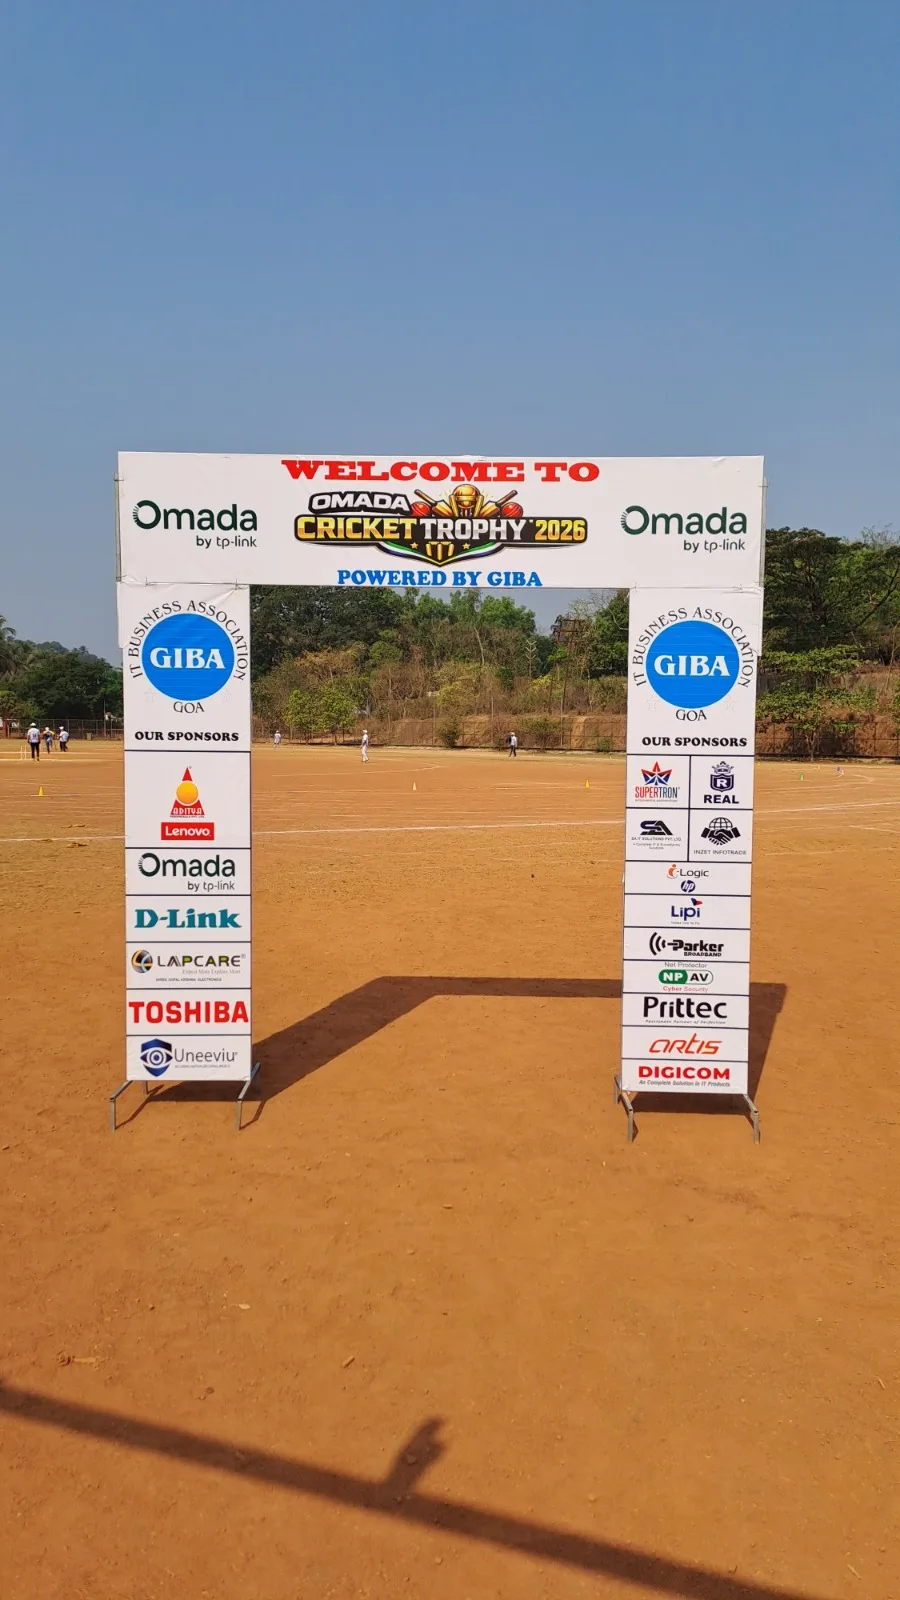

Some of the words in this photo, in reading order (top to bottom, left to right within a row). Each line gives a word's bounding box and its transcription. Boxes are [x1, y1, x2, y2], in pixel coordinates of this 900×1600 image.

[281, 460, 524, 482] WELCOME
[534, 462, 599, 482] TO
[311, 493, 411, 512] OMADA
[133, 500, 257, 531] Omada
[621, 506, 747, 535] Omada
[297, 516, 417, 539] CRICKET
[420, 519, 526, 540] TROPHY
[534, 519, 586, 541] 2026
[196, 536, 211, 549] by
[217, 535, 256, 549] tp-link
[684, 540, 699, 553] by
[704, 539, 745, 553] tp-link
[337, 570, 446, 586] POWERED
[452, 571, 482, 586] BY
[487, 571, 543, 586] GIBA
[128, 600, 182, 658] BUSINESS
[632, 607, 688, 665] BUSINESS
[187, 600, 248, 681] ASSOCIATION
[693, 606, 754, 688] ASSOCIATION
[149, 647, 226, 670] GIBA
[654, 655, 730, 677] GIBA
[129, 663, 144, 679] IT
[632, 672, 647, 687] IT
[172, 702, 206, 715] GOA
[675, 709, 708, 723] GOA
[135, 731, 164, 740] OUR
[168, 732, 238, 741] SPONSORS
[642, 737, 671, 746] OUR
[675, 737, 747, 746] SPONSORS
[716, 779, 728, 788] R
[634, 786, 678, 798] SUPERTRON
[704, 795, 739, 804] REAL
[165, 826, 210, 836] Lenovo
[640, 820, 673, 836] SA
[138, 853, 235, 877] Omada
[187, 880, 200, 892] by
[203, 880, 235, 892] tp-link
[682, 880, 694, 892] hp
[135, 909, 241, 928] D-Link
[671, 906, 700, 921] Lipi
[667, 939, 724, 952] Parker
[663, 972, 683, 981] NP
[690, 973, 709, 981] AV
[129, 1001, 248, 1023] TOSHIBA
[644, 996, 728, 1018] Prittec
[649, 1033, 722, 1054] artis
[638, 1066, 730, 1080] DIGICOM
